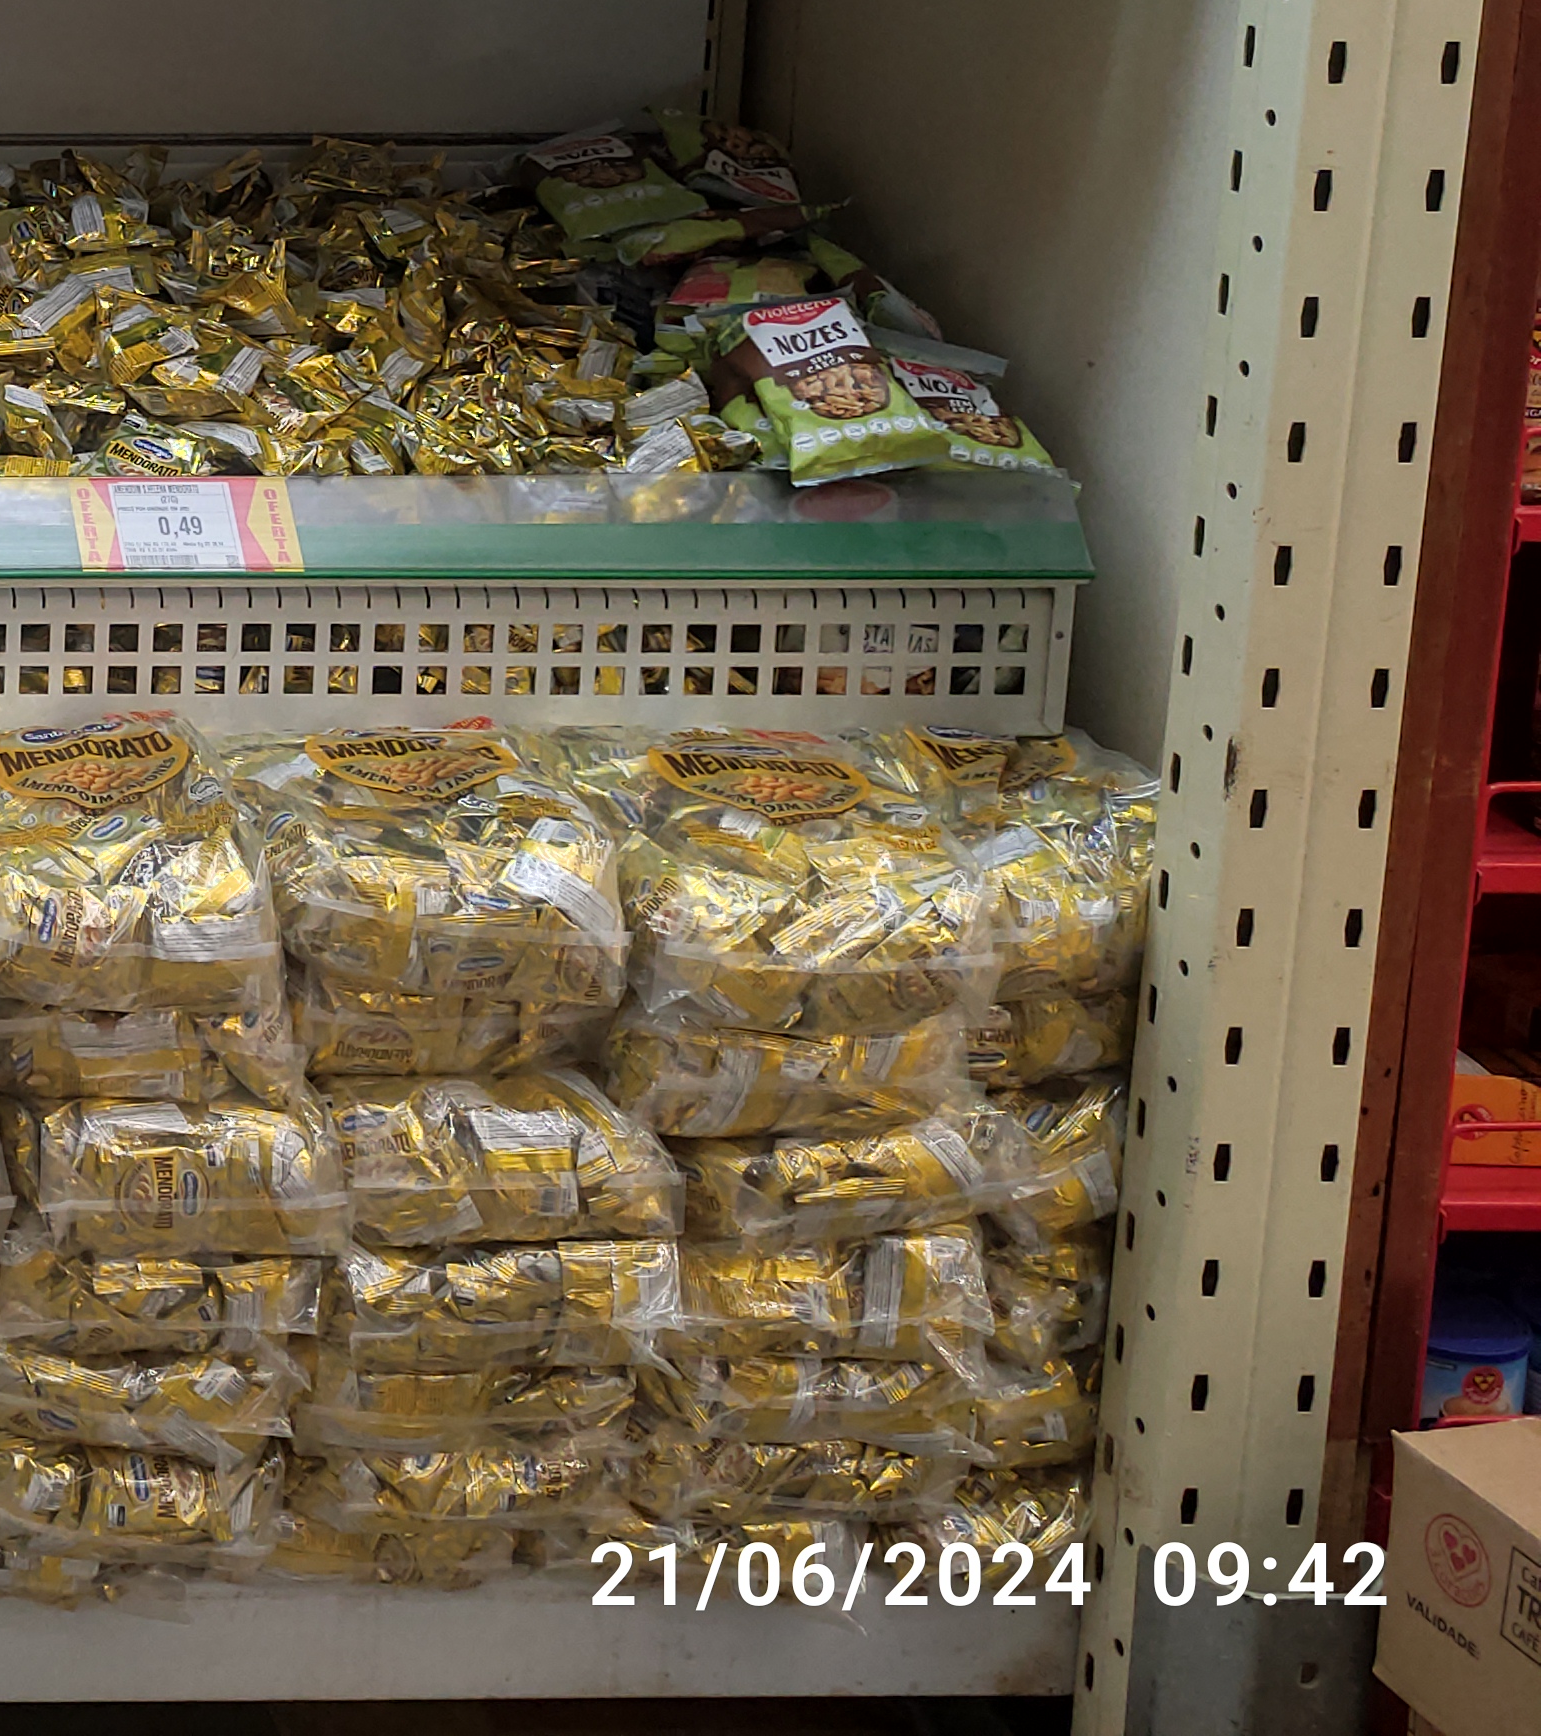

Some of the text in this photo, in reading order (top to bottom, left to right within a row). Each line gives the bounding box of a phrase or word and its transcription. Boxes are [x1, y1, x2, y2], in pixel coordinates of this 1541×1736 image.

[771, 322, 847, 358] NOZES
[76, 488, 103, 563] OFERTA
[158, 515, 203, 538] 0,49
[263, 489, 291, 563] OFERTA
